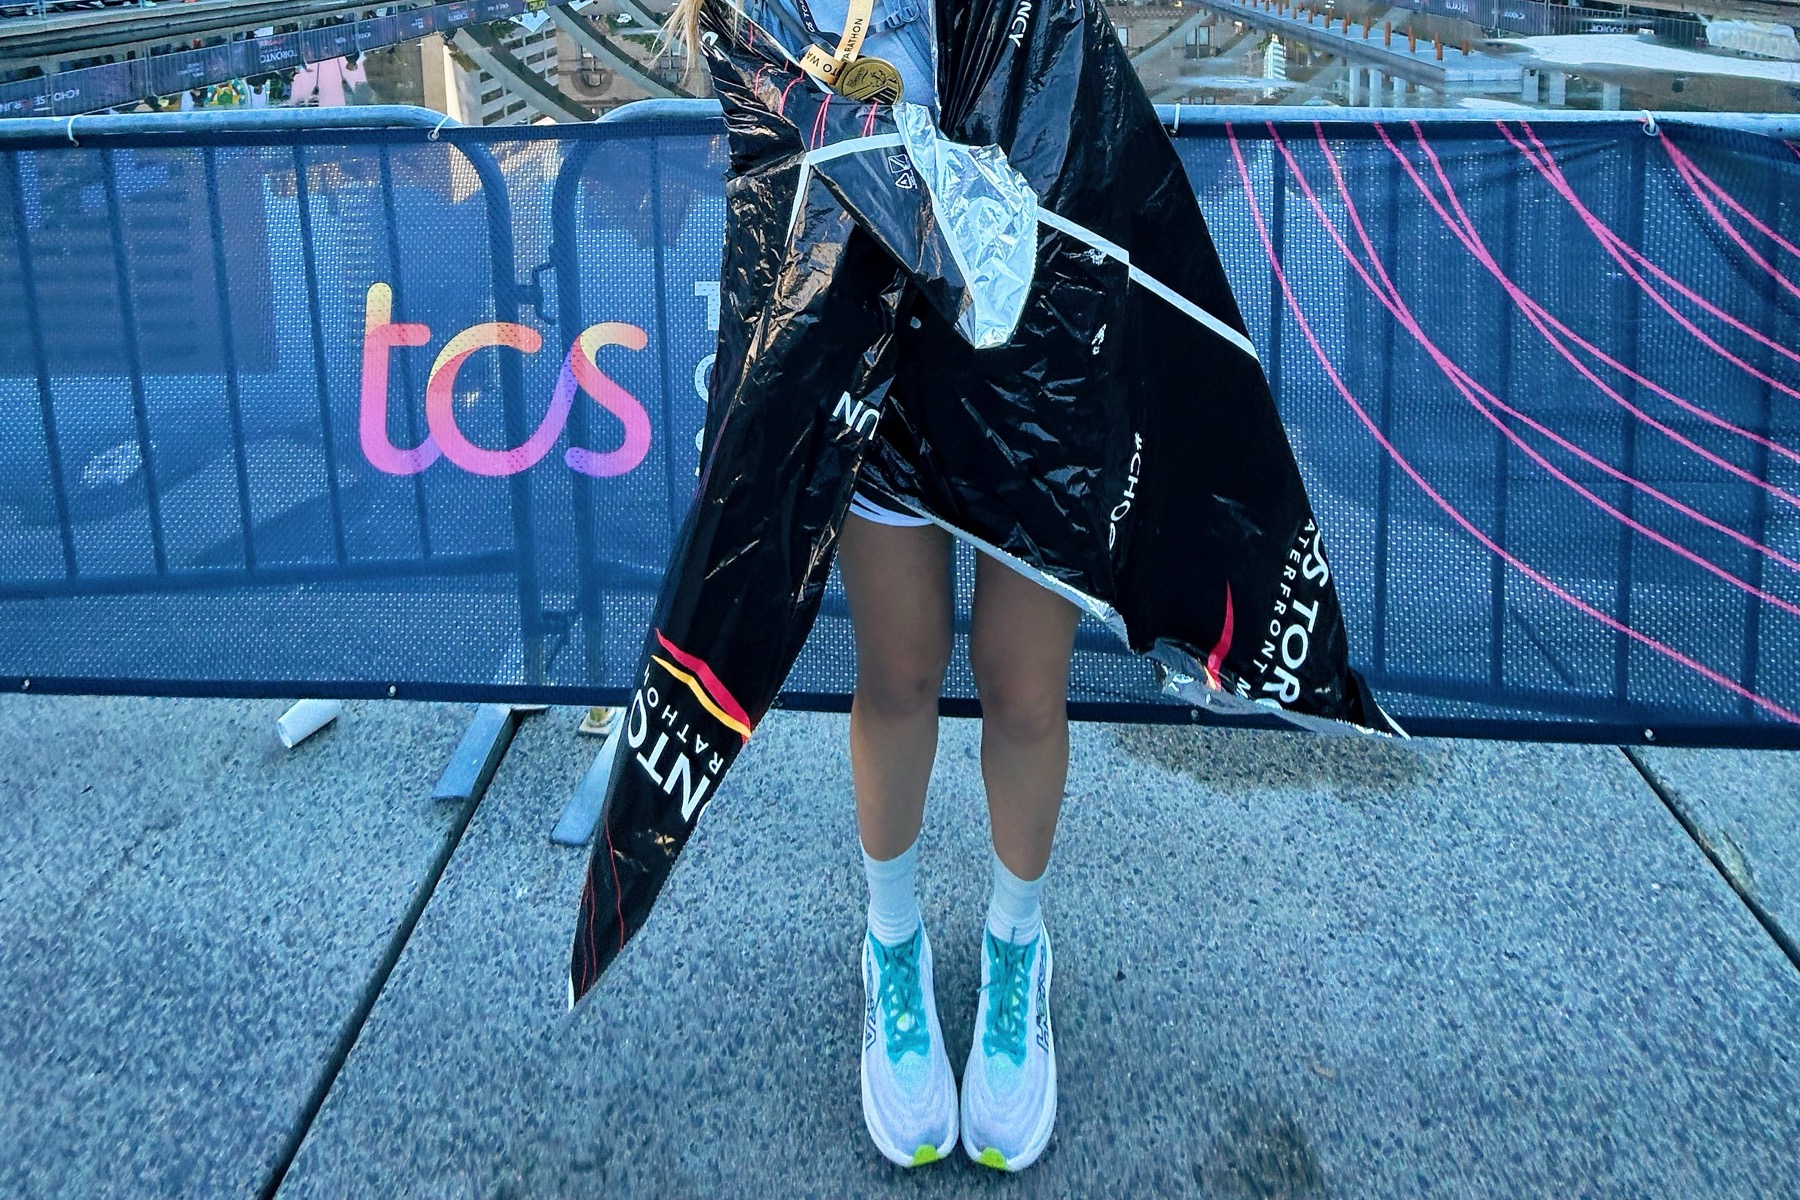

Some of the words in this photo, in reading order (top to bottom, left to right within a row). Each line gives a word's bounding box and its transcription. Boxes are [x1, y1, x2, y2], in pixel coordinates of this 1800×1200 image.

[841, 17, 864, 62] ARATHON
[360, 282, 651, 478] tcs
[1252, 518, 1316, 674] ATERFRONT
[1255, 599, 1319, 710] TOR
[627, 688, 711, 822] NTO
[642, 664, 723, 775] RATHO
